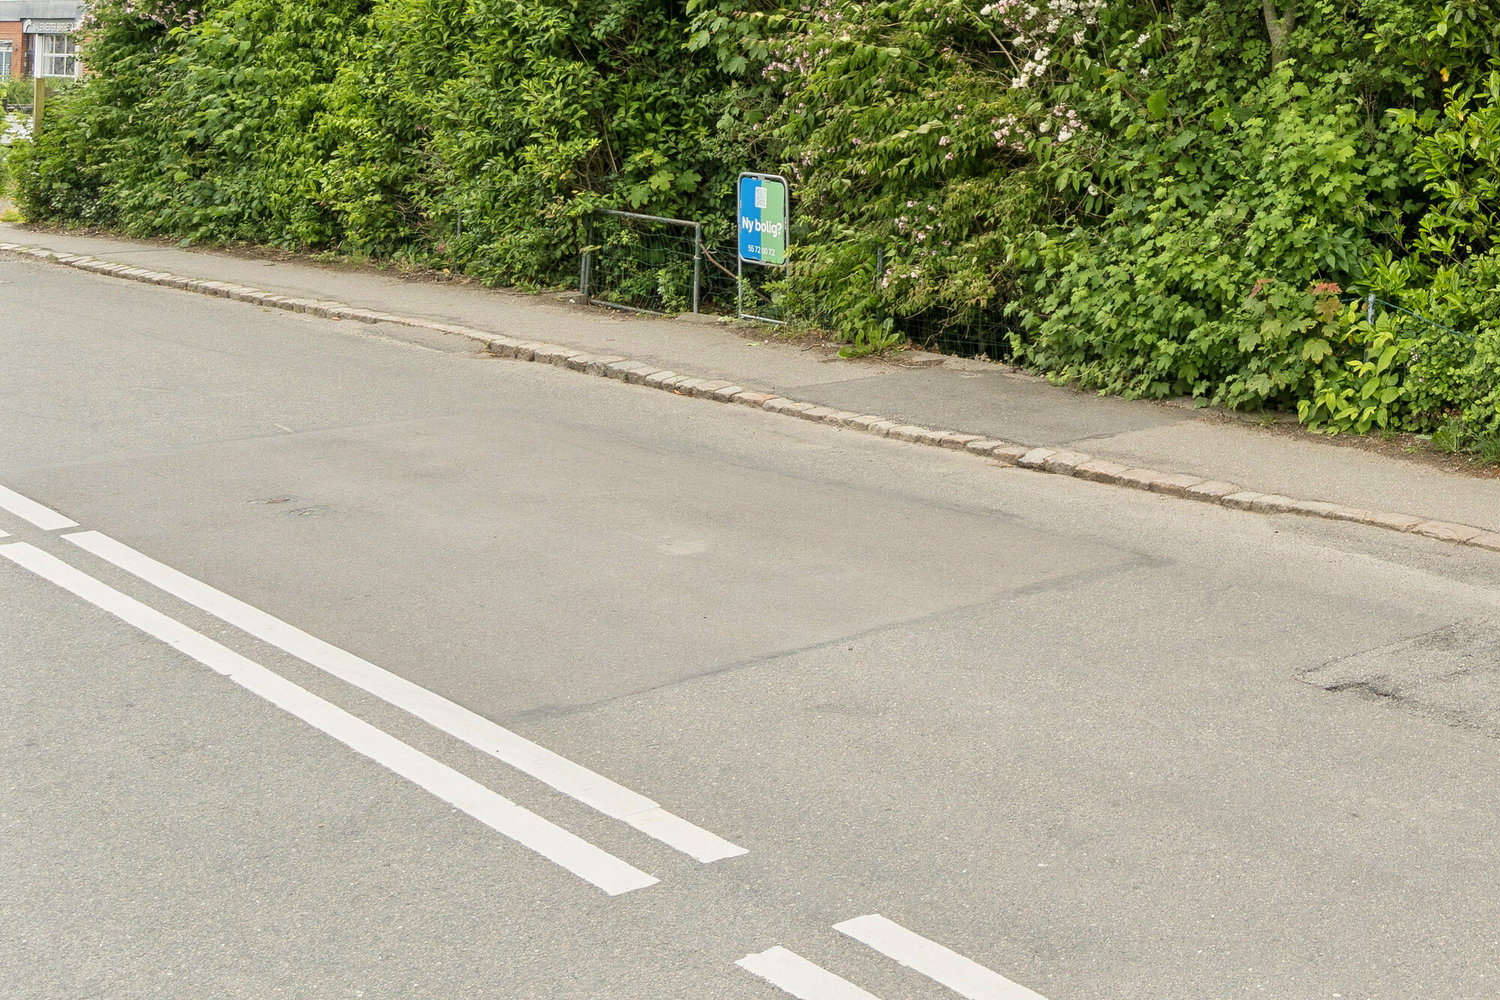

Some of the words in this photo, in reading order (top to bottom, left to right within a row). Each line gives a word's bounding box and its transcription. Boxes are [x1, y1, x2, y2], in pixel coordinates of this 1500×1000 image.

[742, 216, 754, 233] Ny
[754, 218, 782, 238] bolig?
[755, 245, 761, 254] 72
[768, 247, 776, 257] 72
